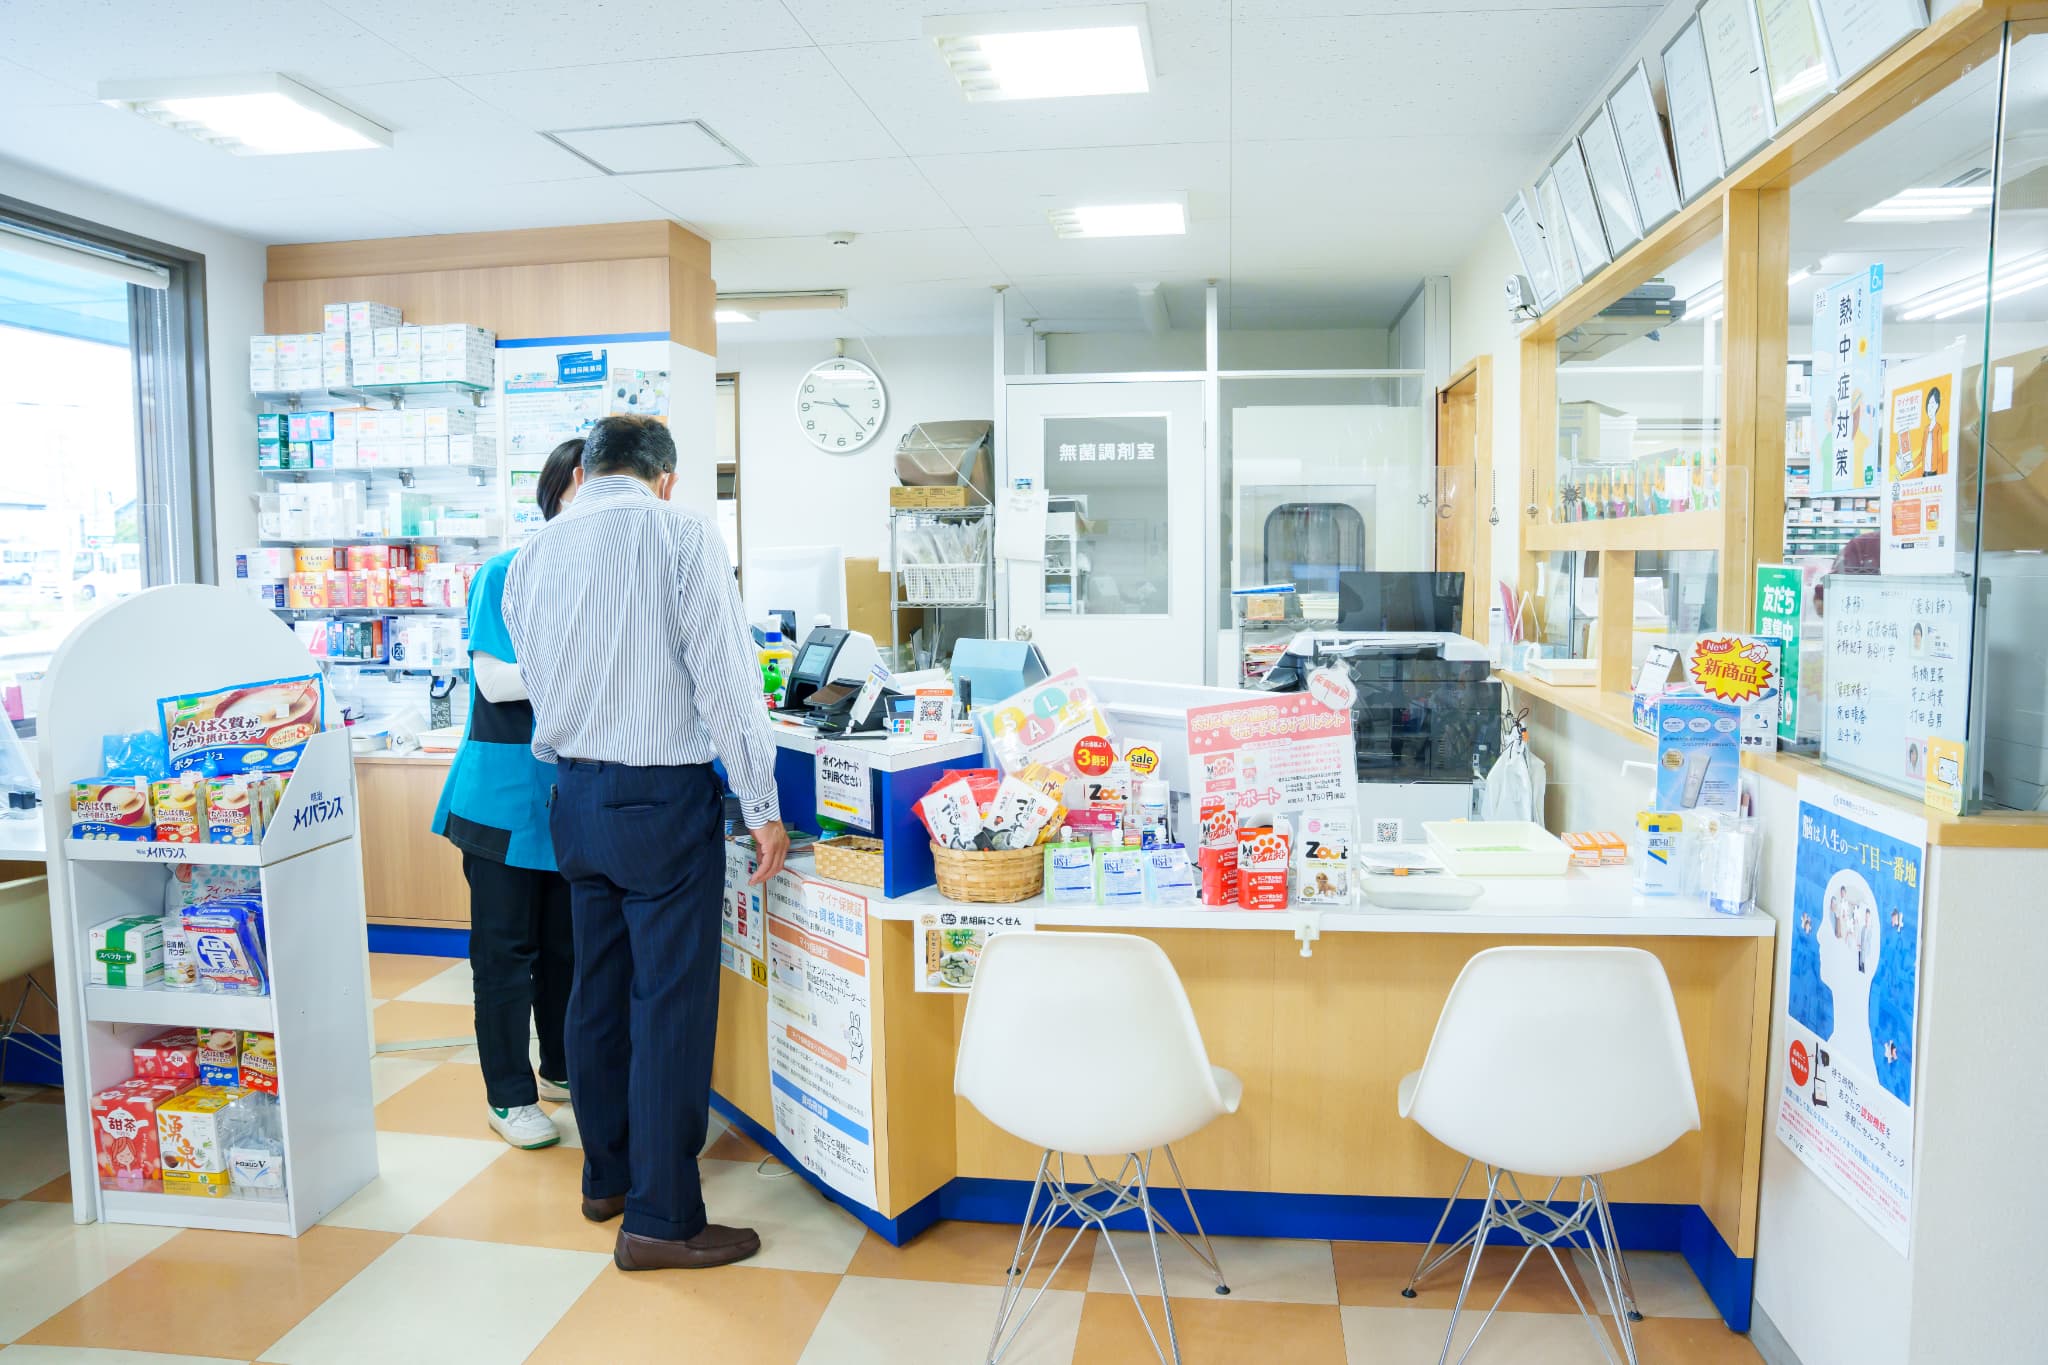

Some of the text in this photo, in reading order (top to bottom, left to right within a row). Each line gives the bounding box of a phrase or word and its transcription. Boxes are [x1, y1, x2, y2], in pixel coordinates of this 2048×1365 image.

[804, 384, 815, 393] 10
[1836, 293, 1854, 478] 熱中症対策
[801, 403, 811, 412] 9
[872, 400, 880, 408] 3
[807, 421, 815, 430] 8
[867, 417, 875, 426] 4
[819, 434, 827, 443] 7
[837, 438, 846, 447] 6
[855, 432, 864, 441] 5
[1058, 442, 1156, 462] 無菌調剤室
[1763, 585, 1795, 615] 友だち
[1704, 658, 1757, 684] 新商品
[171, 716, 258, 740] たんぱく質が
[1230, 711, 1346, 740] サポートするサプリメント
[172, 727, 267, 752] しっかり摂れるスープ
[174, 752, 225, 771] ポタージュ
[822, 754, 860, 773] ポイントカード
[1077, 748, 1109, 767] 3割引
[1131, 753, 1153, 765] sale
[821, 768, 862, 788] ご利用ください
[78, 801, 119, 812] たんぱく質が
[292, 796, 344, 831] メイバランス
[146, 847, 187, 859] メイバランス
[1251, 849, 1286, 864] ワンサポート
[1802, 815, 1917, 888] 脳は人生の一丁目一番地
[817, 890, 863, 919] マイナ保険証
[819, 907, 864, 936] 資格確認書
[98, 950, 133, 962] スペラカーゼ
[199, 937, 235, 969] 骨
[1831, 1067, 1859, 1096] 待ち時間に
[1838, 1089, 1891, 1139] あなたの認知機能を
[108, 1118, 136, 1132] 甜茶
[1844, 1110, 1905, 1168] 手軽にセルフチェック
